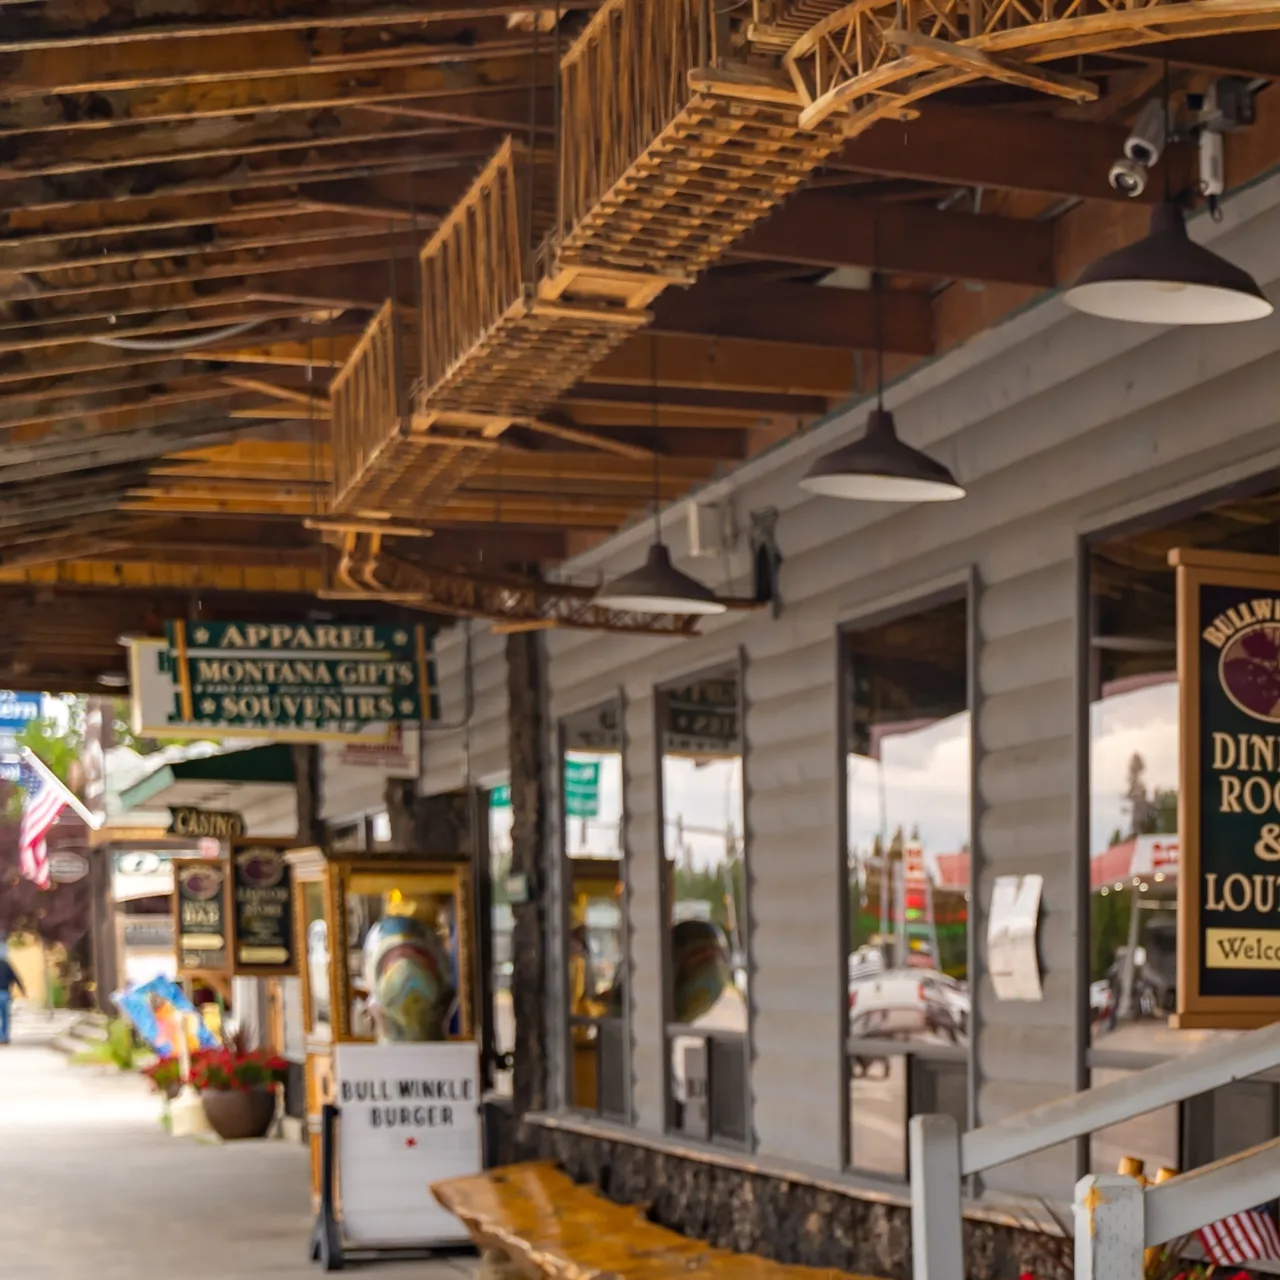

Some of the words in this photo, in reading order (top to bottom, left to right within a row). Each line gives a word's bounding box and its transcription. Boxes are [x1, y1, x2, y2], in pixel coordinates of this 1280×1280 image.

[219, 625, 384, 649] APPAREL
[199, 660, 331, 684] MONTANA
[336, 661, 414, 686] GIFTS
[221, 695, 394, 719] SOUVENIRS
[174, 808, 243, 837] CASINO
[371, 1105, 453, 1128] BURGER
